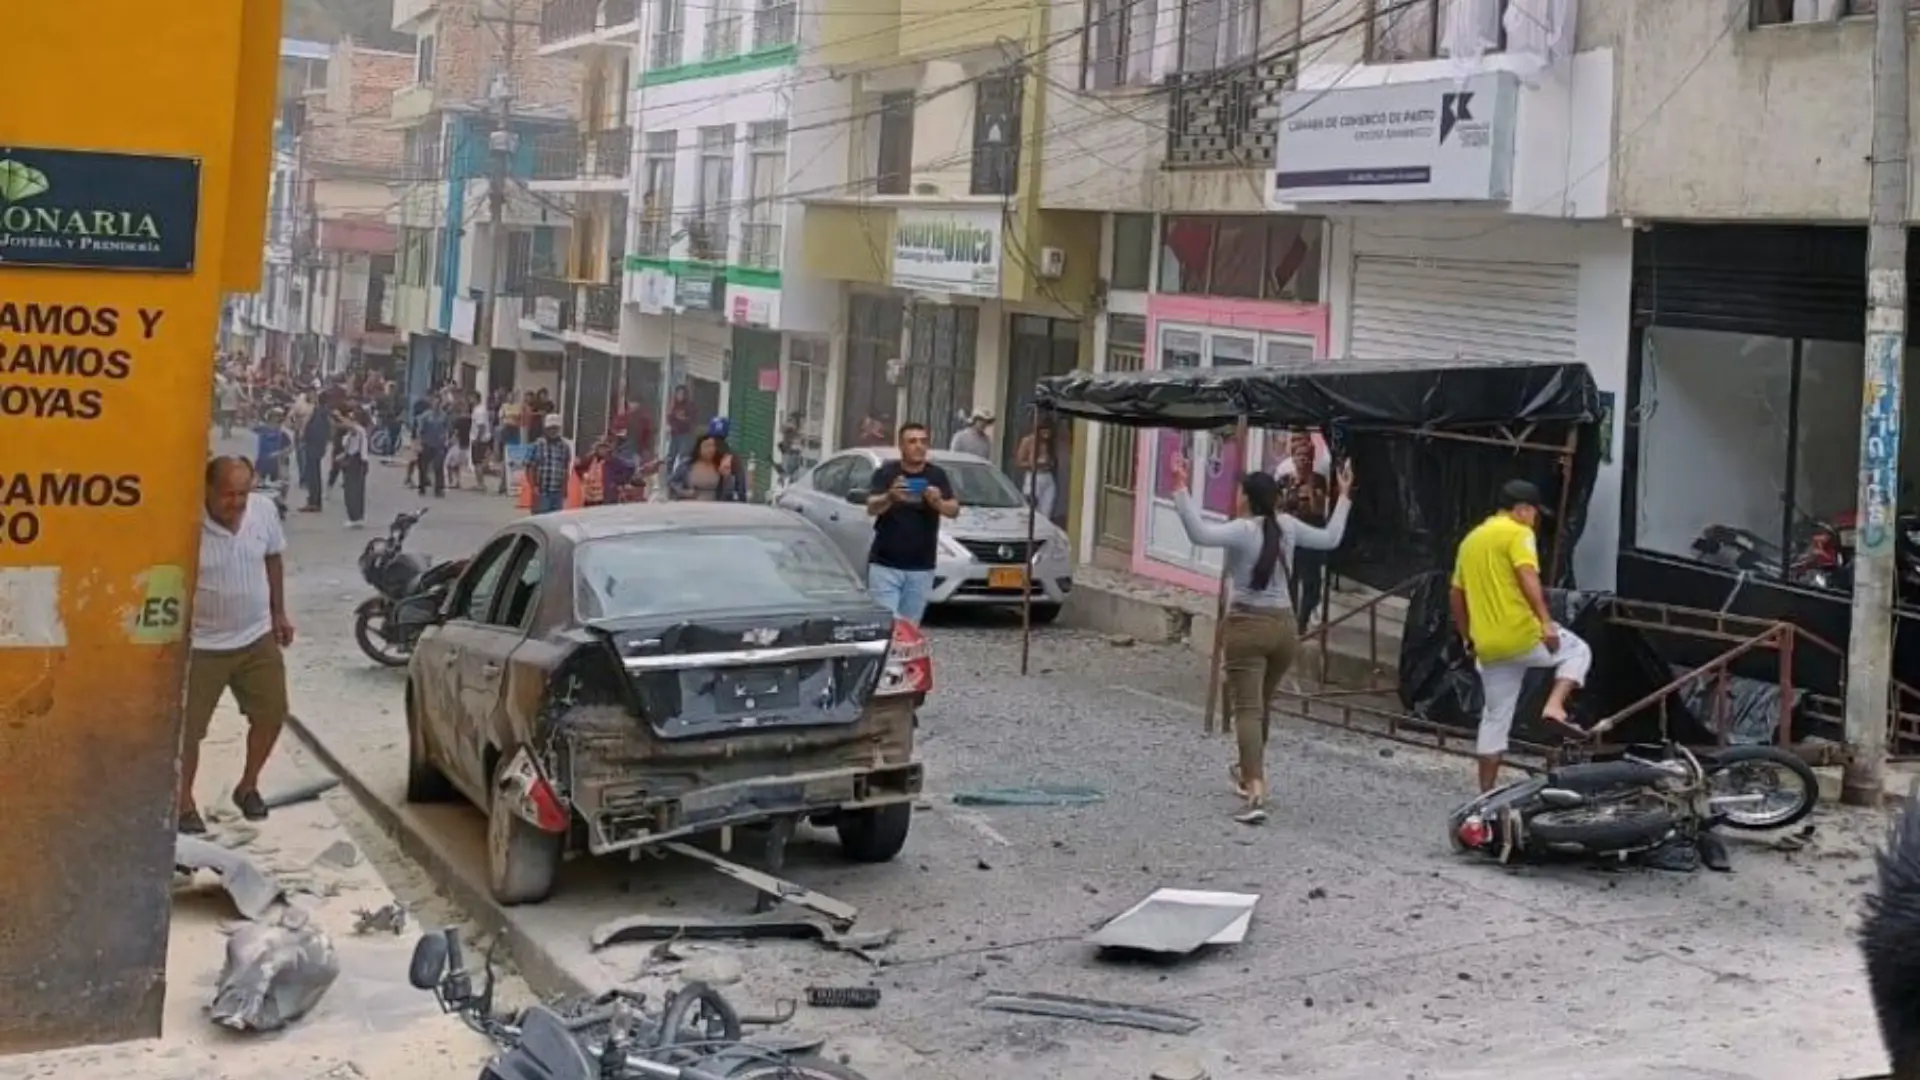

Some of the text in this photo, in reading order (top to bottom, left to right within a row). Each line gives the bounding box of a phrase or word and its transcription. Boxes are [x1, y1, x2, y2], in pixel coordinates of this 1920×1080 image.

[3, 205, 161, 239] ONARIA
[0, 302, 164, 339] AMOS Y
[0, 384, 103, 419] OYAS
[0, 472, 141, 507] AMOS
[0, 511, 39, 544] O
[136, 596, 179, 627] ES
